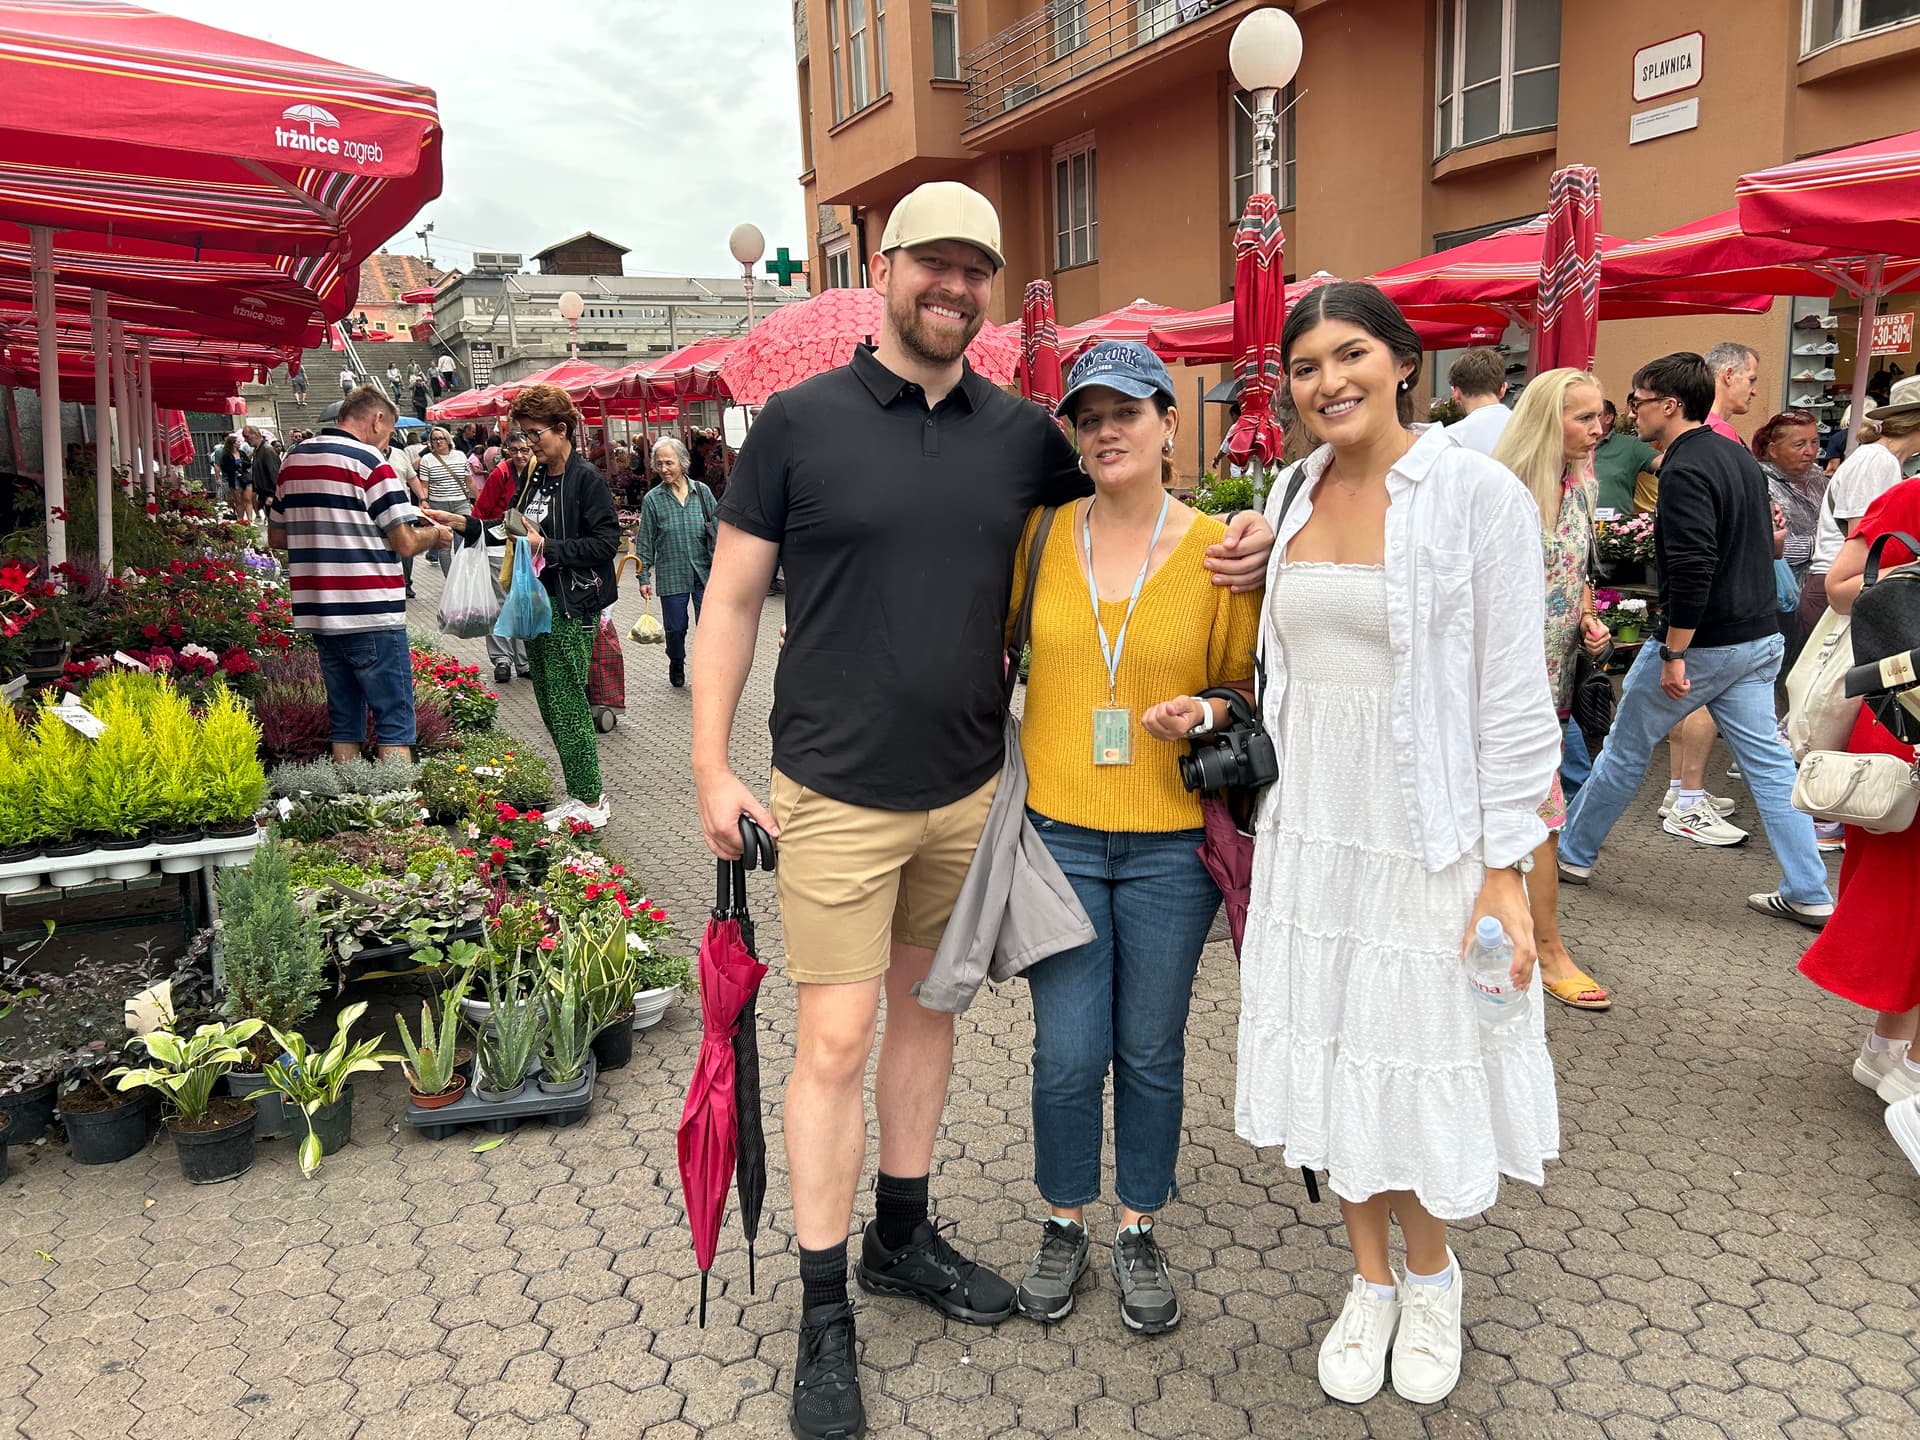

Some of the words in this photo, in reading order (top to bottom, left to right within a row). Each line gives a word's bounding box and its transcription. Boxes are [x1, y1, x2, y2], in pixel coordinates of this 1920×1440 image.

[1642, 52, 1692, 82] SPLAVNICA
[275, 126, 340, 154] tržnice
[343, 141, 383, 164] zagreb
[1873, 315, 1906, 326] OPUST
[1098, 346, 1142, 369] YORK
